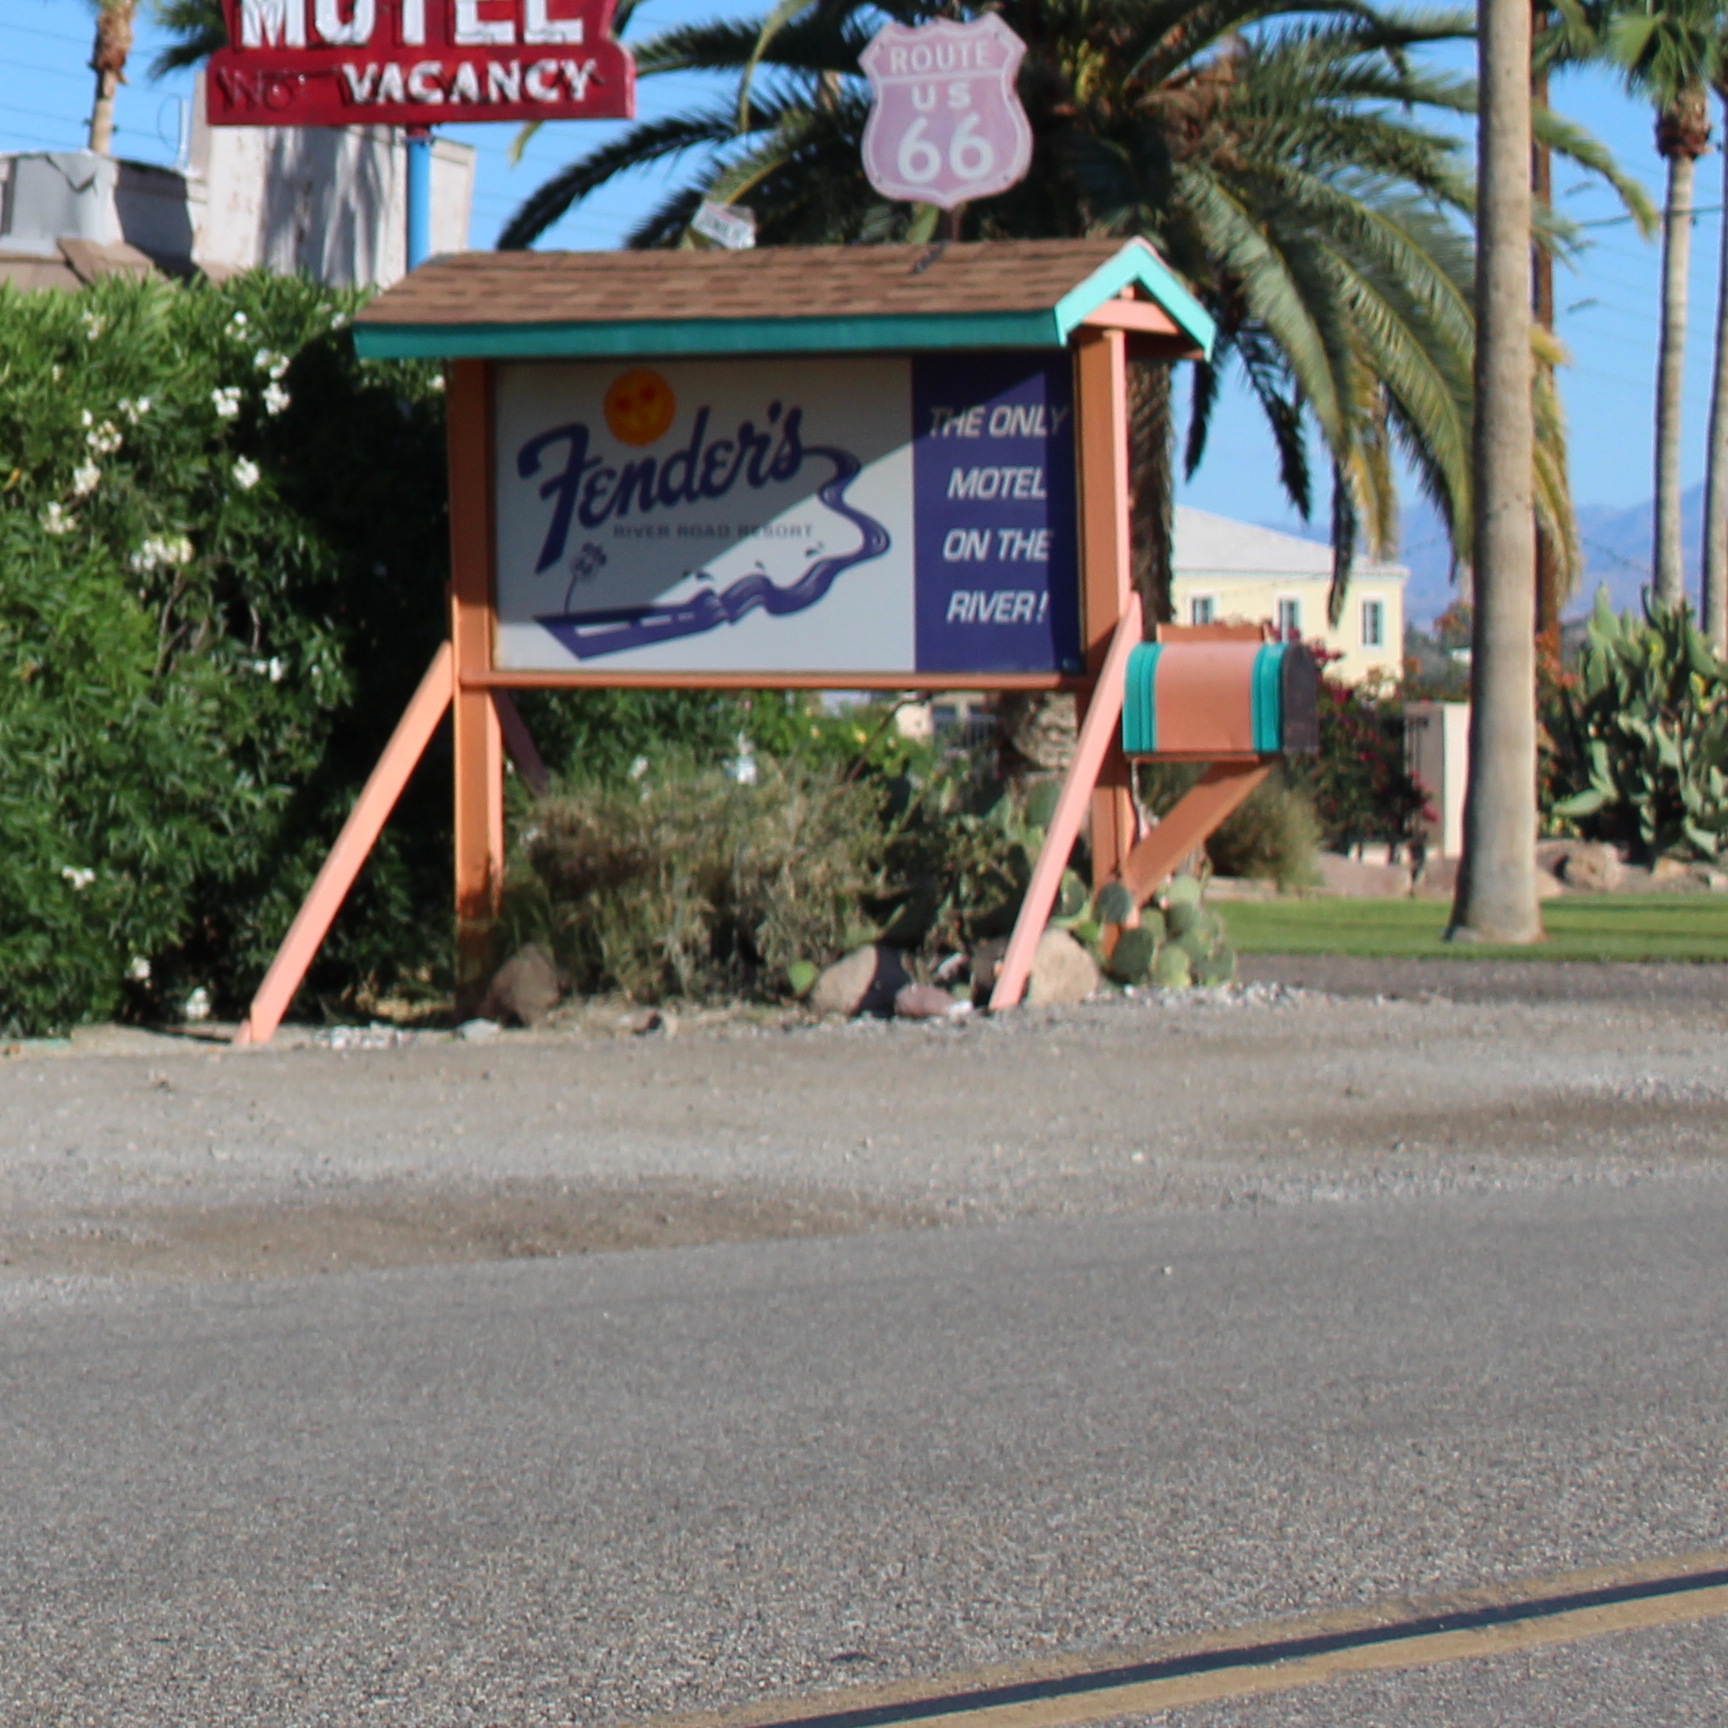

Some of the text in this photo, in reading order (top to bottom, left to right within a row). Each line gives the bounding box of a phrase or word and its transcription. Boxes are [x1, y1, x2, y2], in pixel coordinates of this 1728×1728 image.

[888, 40, 990, 74] ROUTE
[342, 58, 600, 106] VACANCY
[897, 111, 995, 184] 66
[929, 403, 1070, 439] THE ONLY
[516, 400, 804, 575] Fender's
[946, 466, 1049, 501] MOTEL
[612, 523, 814, 539] RIVER ROAD RESORT
[942, 528, 1055, 563] ON THE
[945, 589, 1050, 624] RIVER!
